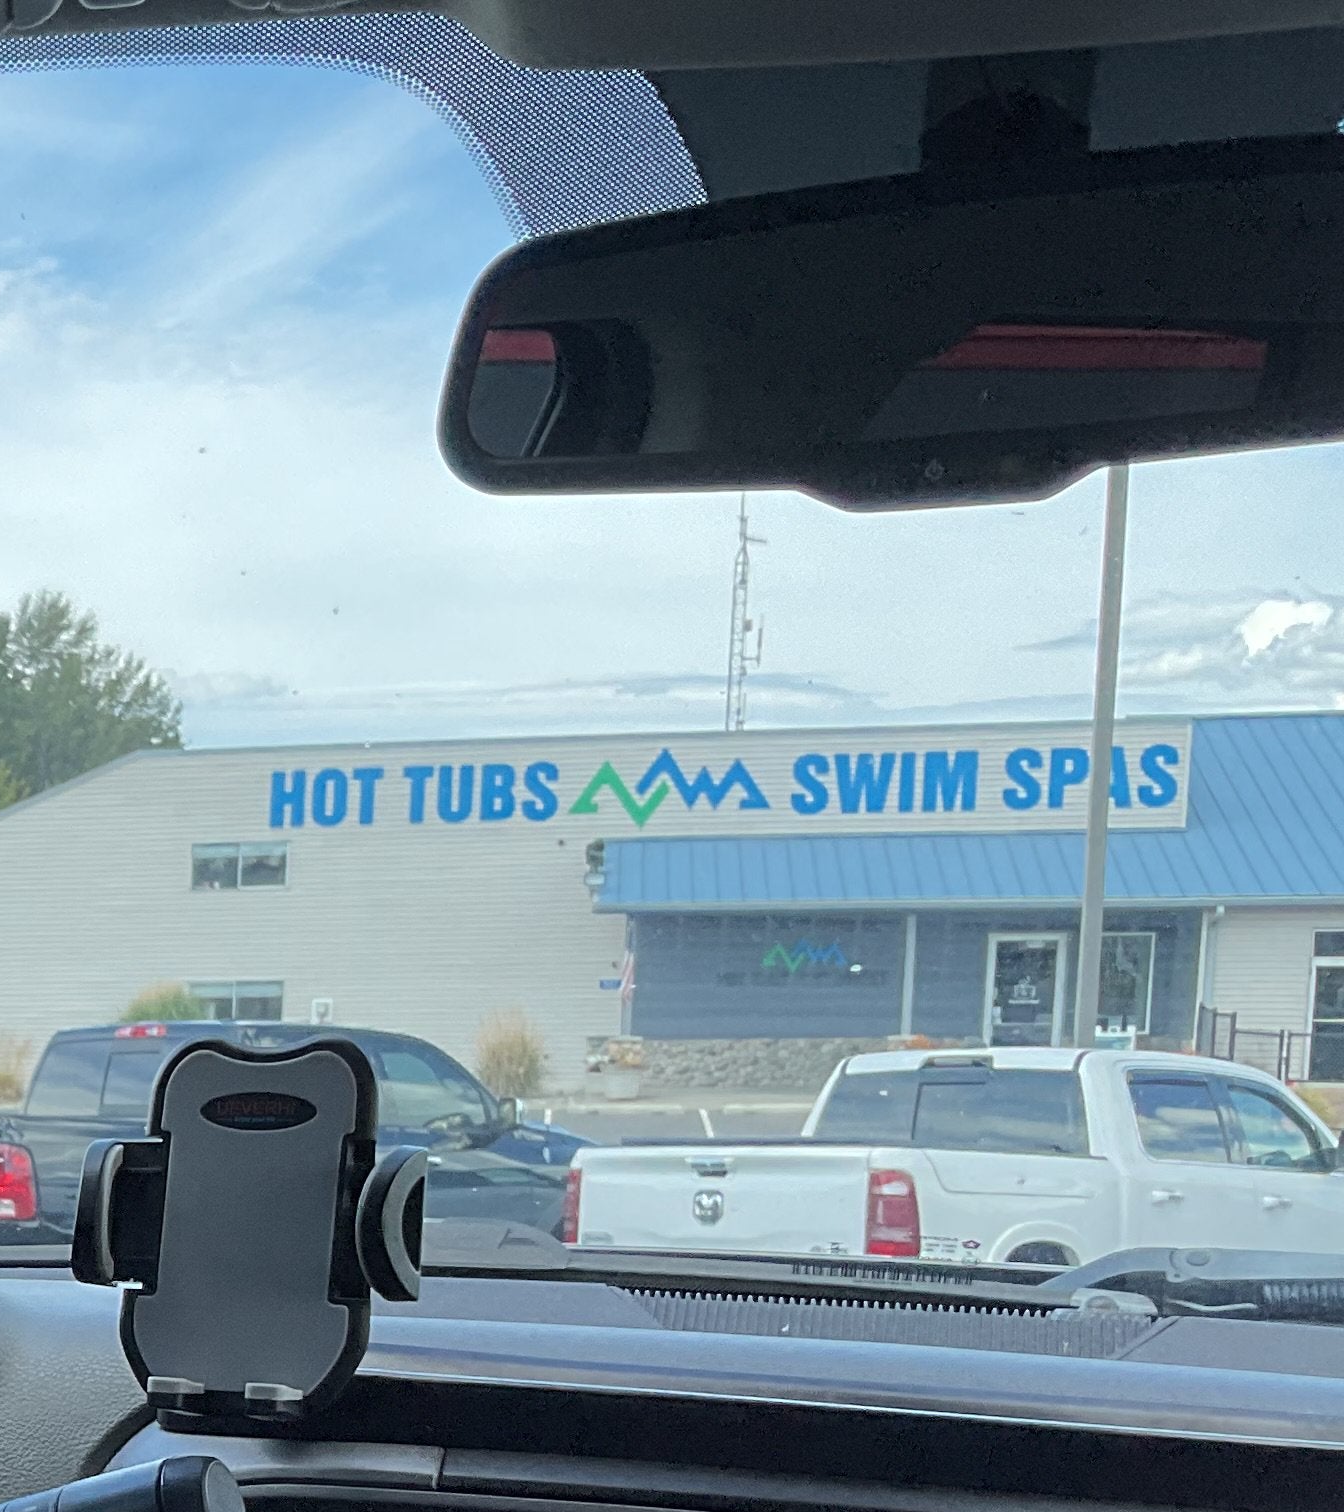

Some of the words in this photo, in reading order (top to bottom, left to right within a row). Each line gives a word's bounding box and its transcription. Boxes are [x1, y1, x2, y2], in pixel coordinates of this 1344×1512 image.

[270, 768, 384, 827] HOT
[404, 761, 559, 824] TUBS
[791, 750, 979, 815] SWIM
[1002, 743, 1179, 811] SPAS
